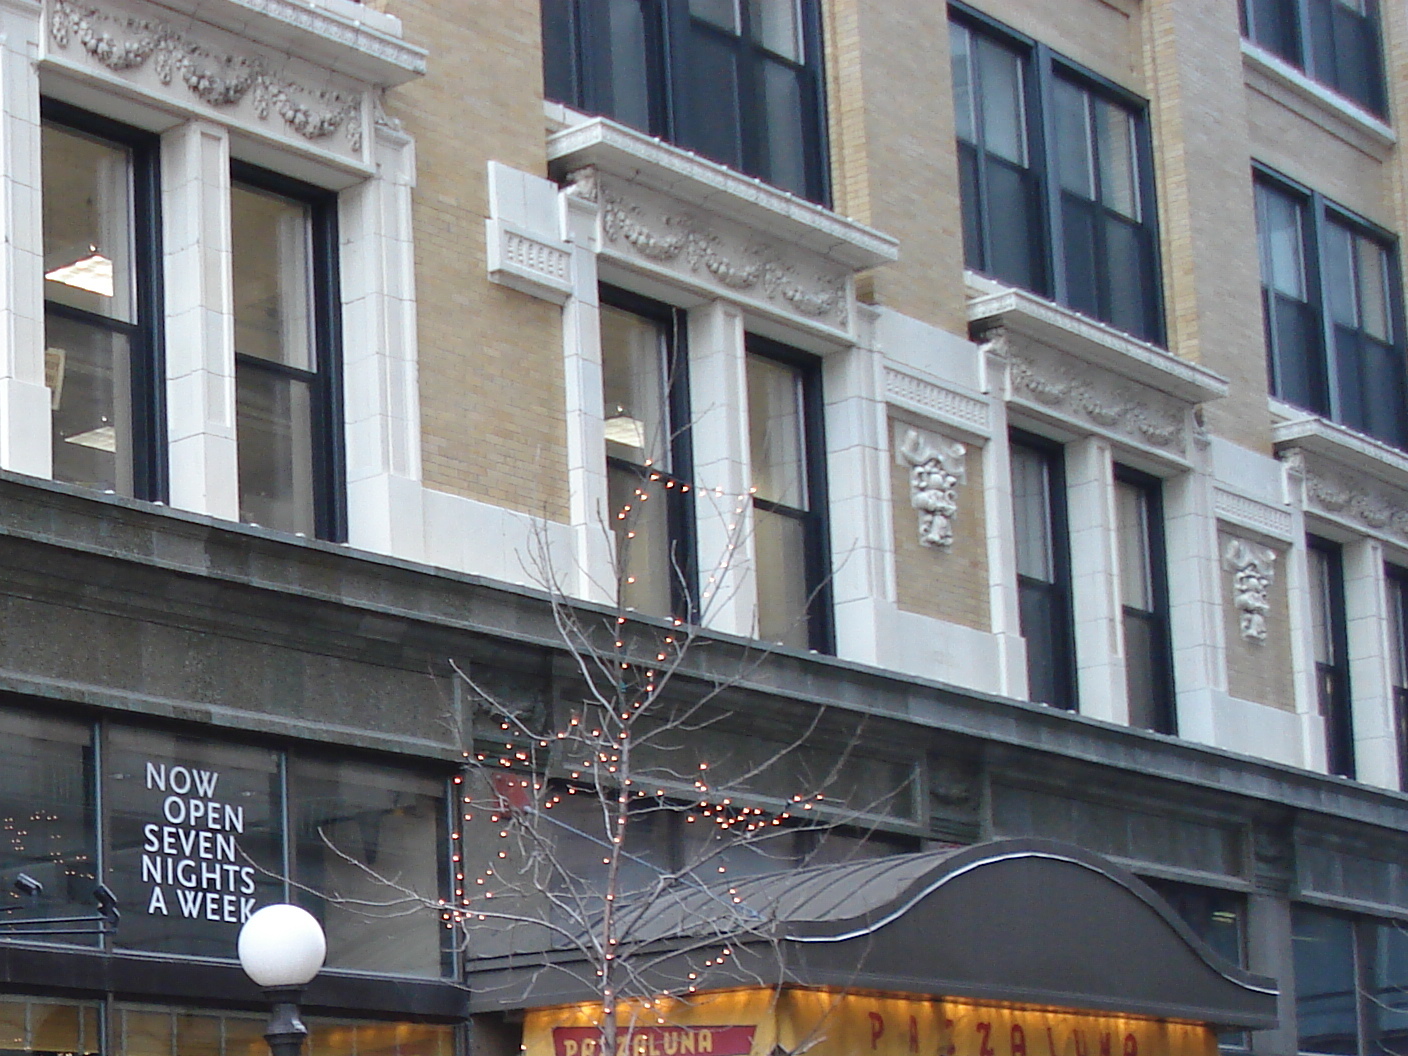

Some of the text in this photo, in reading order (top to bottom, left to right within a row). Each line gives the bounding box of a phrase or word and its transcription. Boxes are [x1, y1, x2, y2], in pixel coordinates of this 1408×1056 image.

[145, 761, 219, 799] NOW
[163, 795, 245, 834] OPEN
[143, 823, 237, 863] SEVEN
[141, 854, 257, 896] NIGHTS
[147, 886, 257, 925] A WEEK
